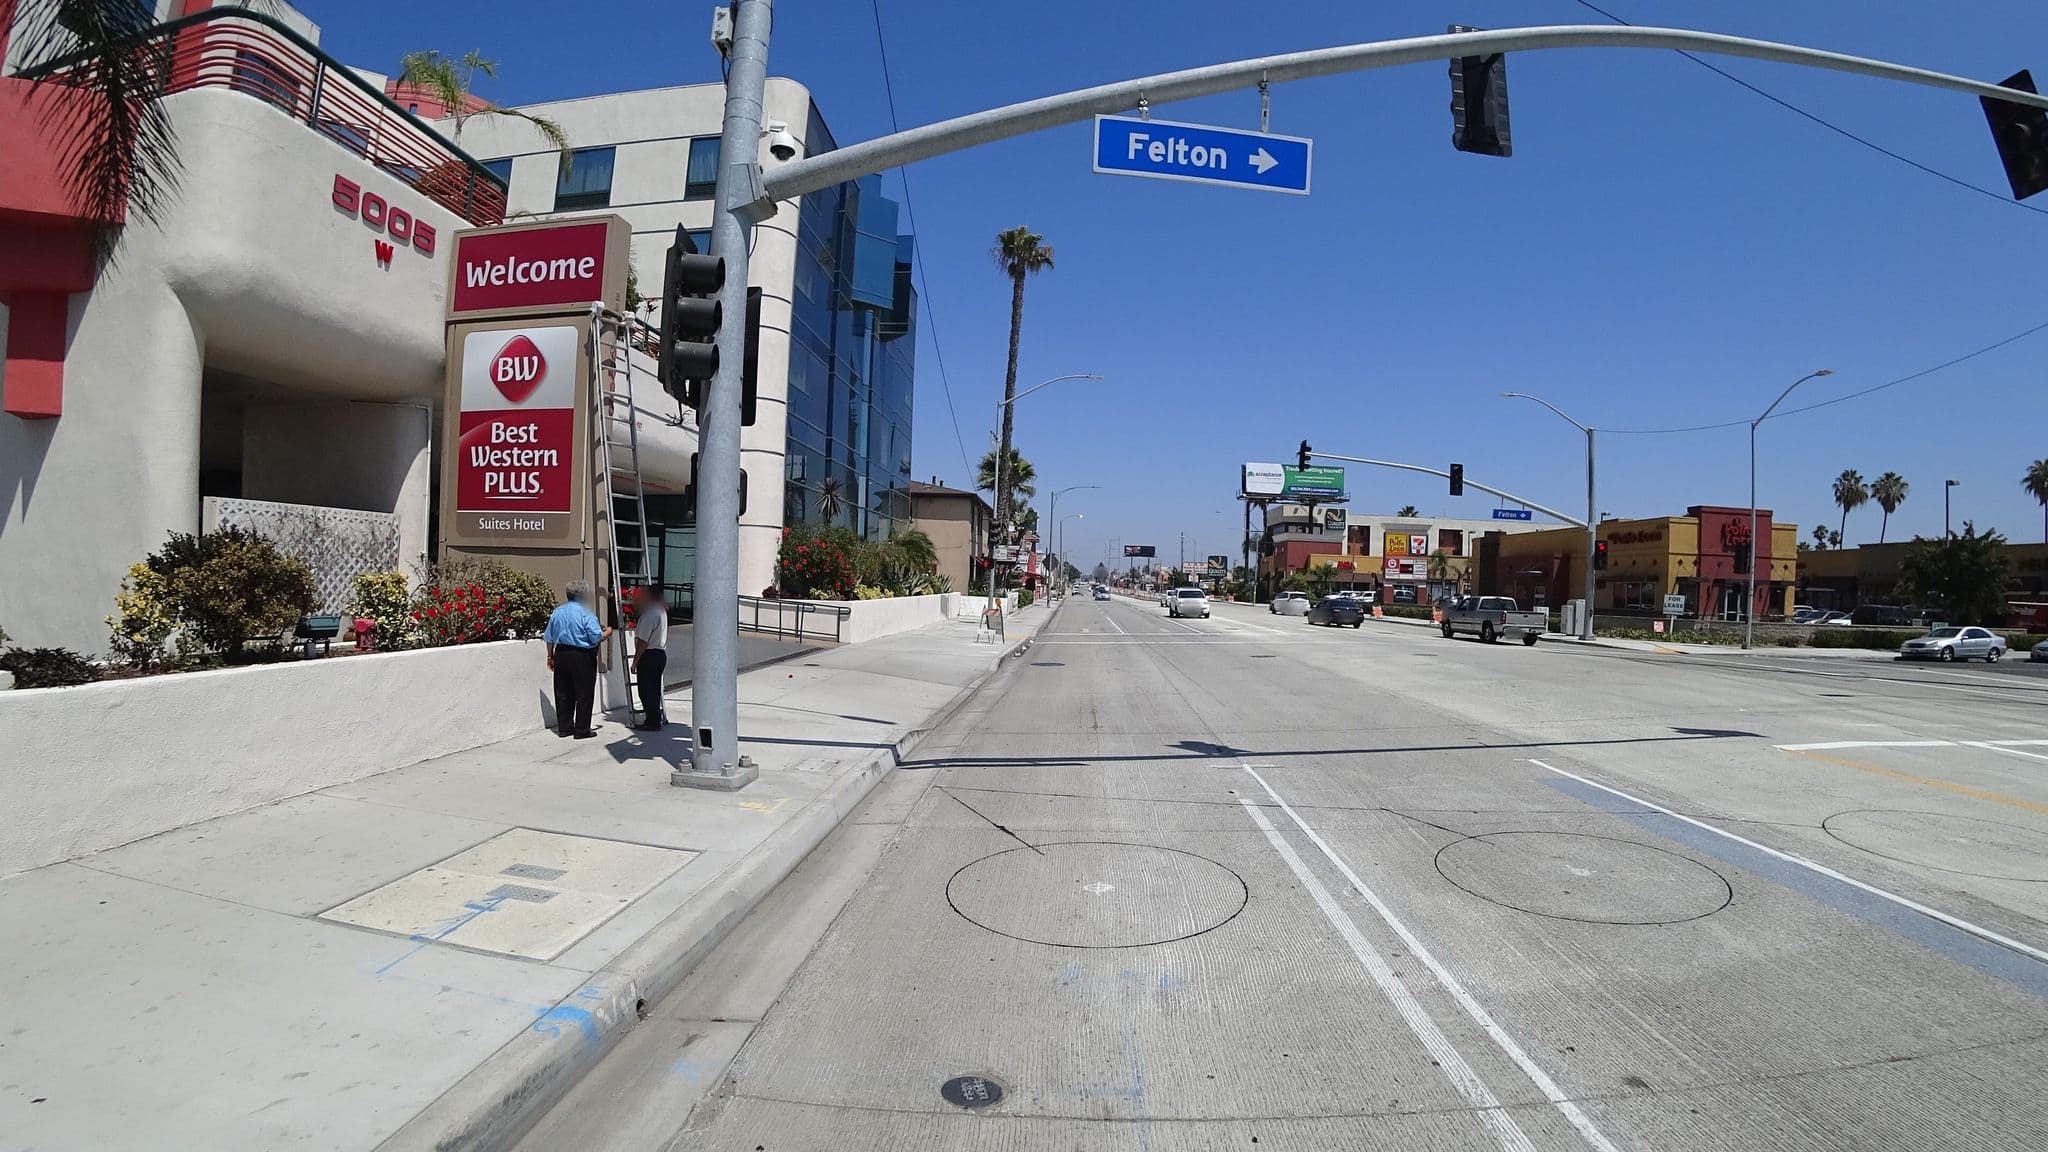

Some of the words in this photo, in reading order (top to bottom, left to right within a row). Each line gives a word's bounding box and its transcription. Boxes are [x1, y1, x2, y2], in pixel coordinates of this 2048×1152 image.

[1128, 133, 1227, 170] Felton
[332, 174, 437, 254] 5005
[374, 239, 394, 264] W
[466, 256, 595, 288] Welcome
[497, 356, 539, 382] BW
[491, 422, 538, 444] Best
[471, 446, 559, 467] Western
[485, 472, 540, 494] PLUS
[479, 517, 511, 530] Suites
[513, 518, 545, 531] Hotel
